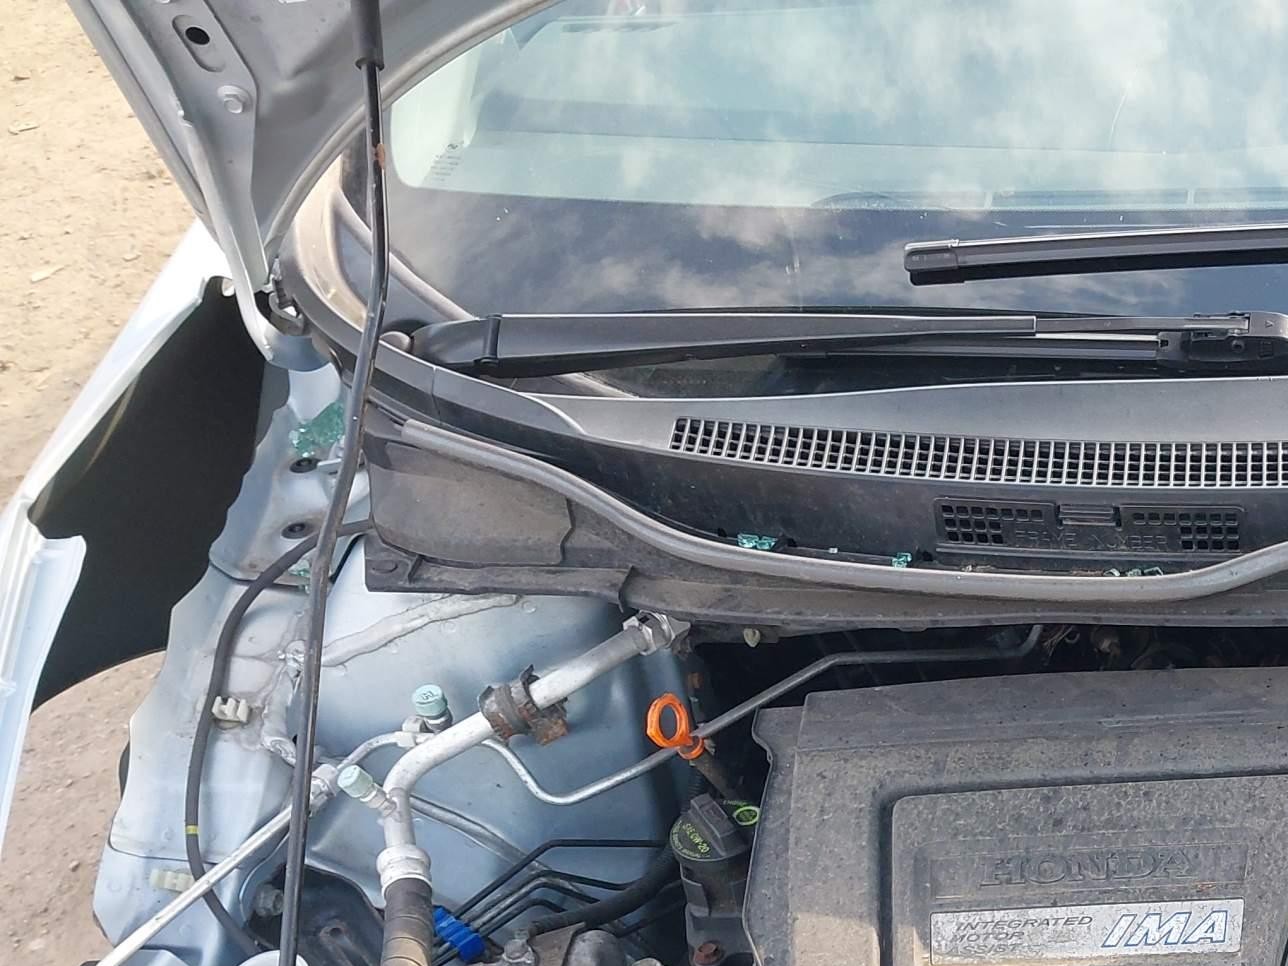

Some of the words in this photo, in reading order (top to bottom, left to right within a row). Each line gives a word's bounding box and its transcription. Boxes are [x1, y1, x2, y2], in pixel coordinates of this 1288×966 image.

[1015, 529, 1077, 547] FRAME
[979, 850, 1197, 887] HONDA
[956, 915, 1093, 933] INTEGRATED
[1101, 909, 1229, 948] IMA
[950, 930, 1025, 944] MOTOR
[946, 943, 1021, 957] ASSIST
